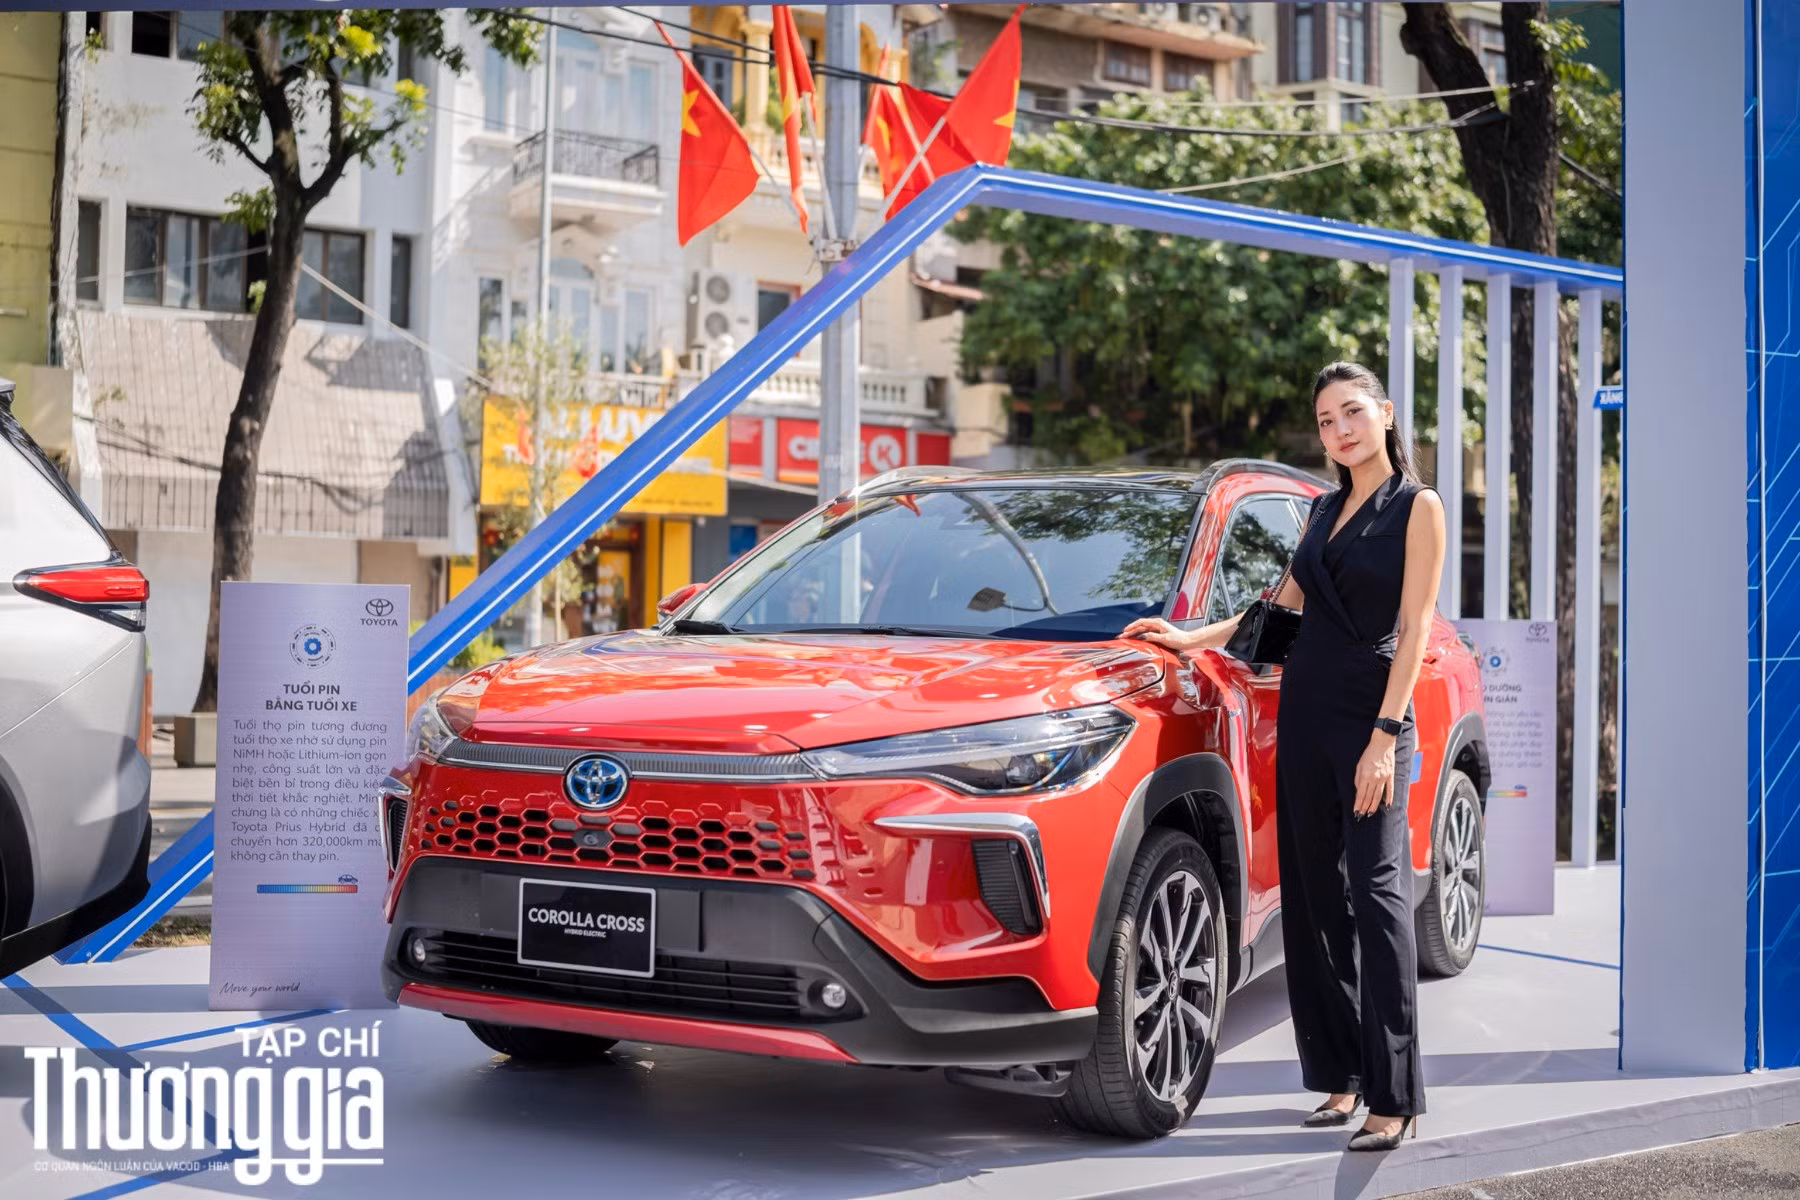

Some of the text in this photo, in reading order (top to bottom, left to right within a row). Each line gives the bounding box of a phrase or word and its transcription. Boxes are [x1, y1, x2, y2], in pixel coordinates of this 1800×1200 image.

[361, 618, 398, 626] TOYOTA
[283, 680, 341, 695] TUỔI PIN
[265, 695, 358, 711] BẰNG TUỔI XE
[233, 718, 387, 733] Tuổi thọ pin tương đương
[233, 733, 387, 748] tuổi thọ xe nhờ sử dụng pin
[233, 749, 387, 763] NiMH hoặc Lithium-ion gọn
[262, 764, 291, 776] công
[296, 764, 320, 774] suất
[325, 764, 343, 775] lớn
[347, 765, 361, 775] và
[365, 764, 386, 776] đặc
[232, 778, 254, 790] biệt
[258, 778, 280, 789] bền
[300, 779, 330, 790] trong
[334, 778, 359, 789] điều
[232, 791, 379, 806] thời tiết khắc nghiệt. Min
[231, 808, 267, 820] chứng
[270, 808, 281, 818] là
[284, 808, 298, 818] có
[301, 808, 338, 820] những
[340, 808, 370, 819] chiếc
[232, 822, 268, 834] Toyota
[275, 822, 302, 833] Prius
[309, 822, 346, 835] Hybrid
[352, 822, 367, 833] đã
[230, 836, 271, 849] chuyển
[275, 837, 298, 847] hơn
[302, 837, 363, 848] 320,000km
[230, 850, 340, 863] không cần thay pin.
[528, 907, 646, 933] COROLLA CROSS
[564, 928, 607, 938] HYBRID ELECTRIC
[219, 982, 301, 998] Move your world
